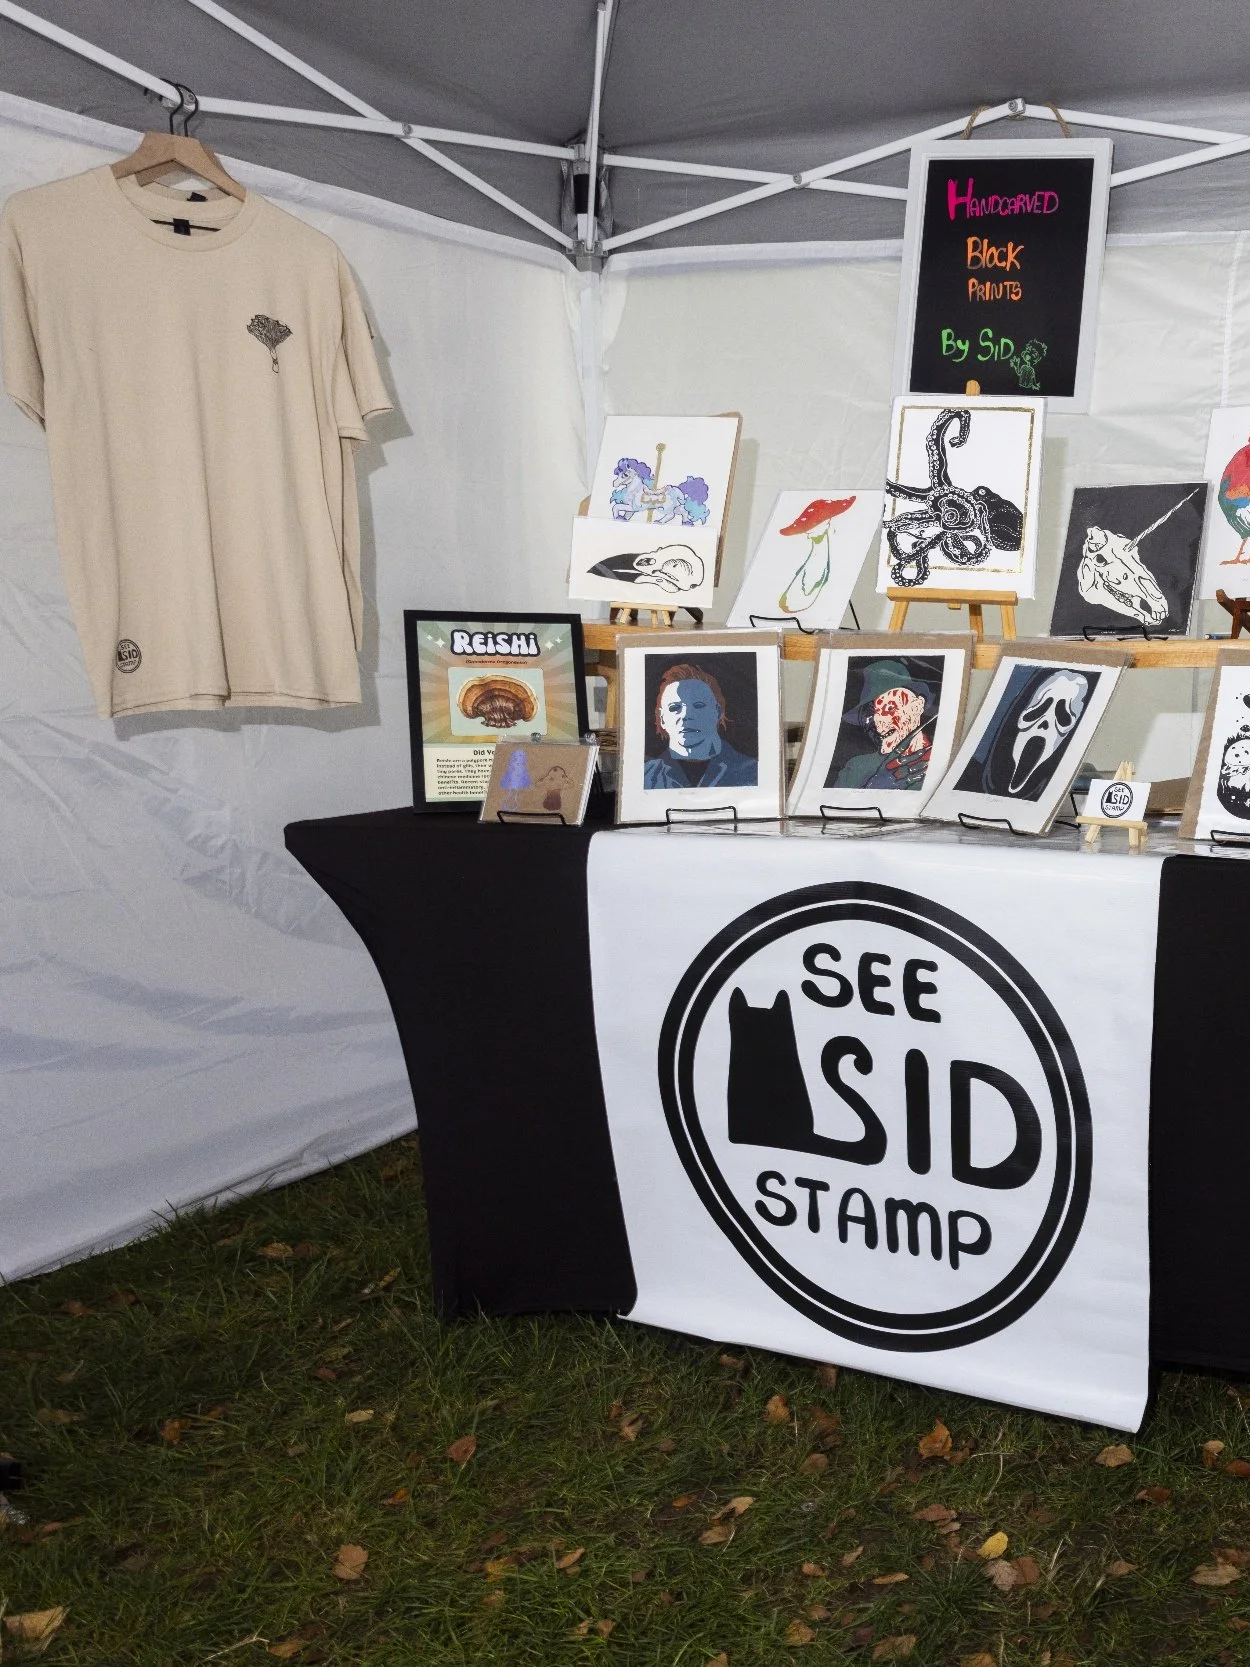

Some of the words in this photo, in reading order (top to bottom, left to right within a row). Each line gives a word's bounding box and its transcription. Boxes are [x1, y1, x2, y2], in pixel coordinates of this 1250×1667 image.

[941, 328, 970, 363] By
[122, 649, 138, 661] SID
[1112, 794, 1130, 805] SID
[801, 942, 942, 1024] SEE
[818, 1035, 1042, 1190] SID
